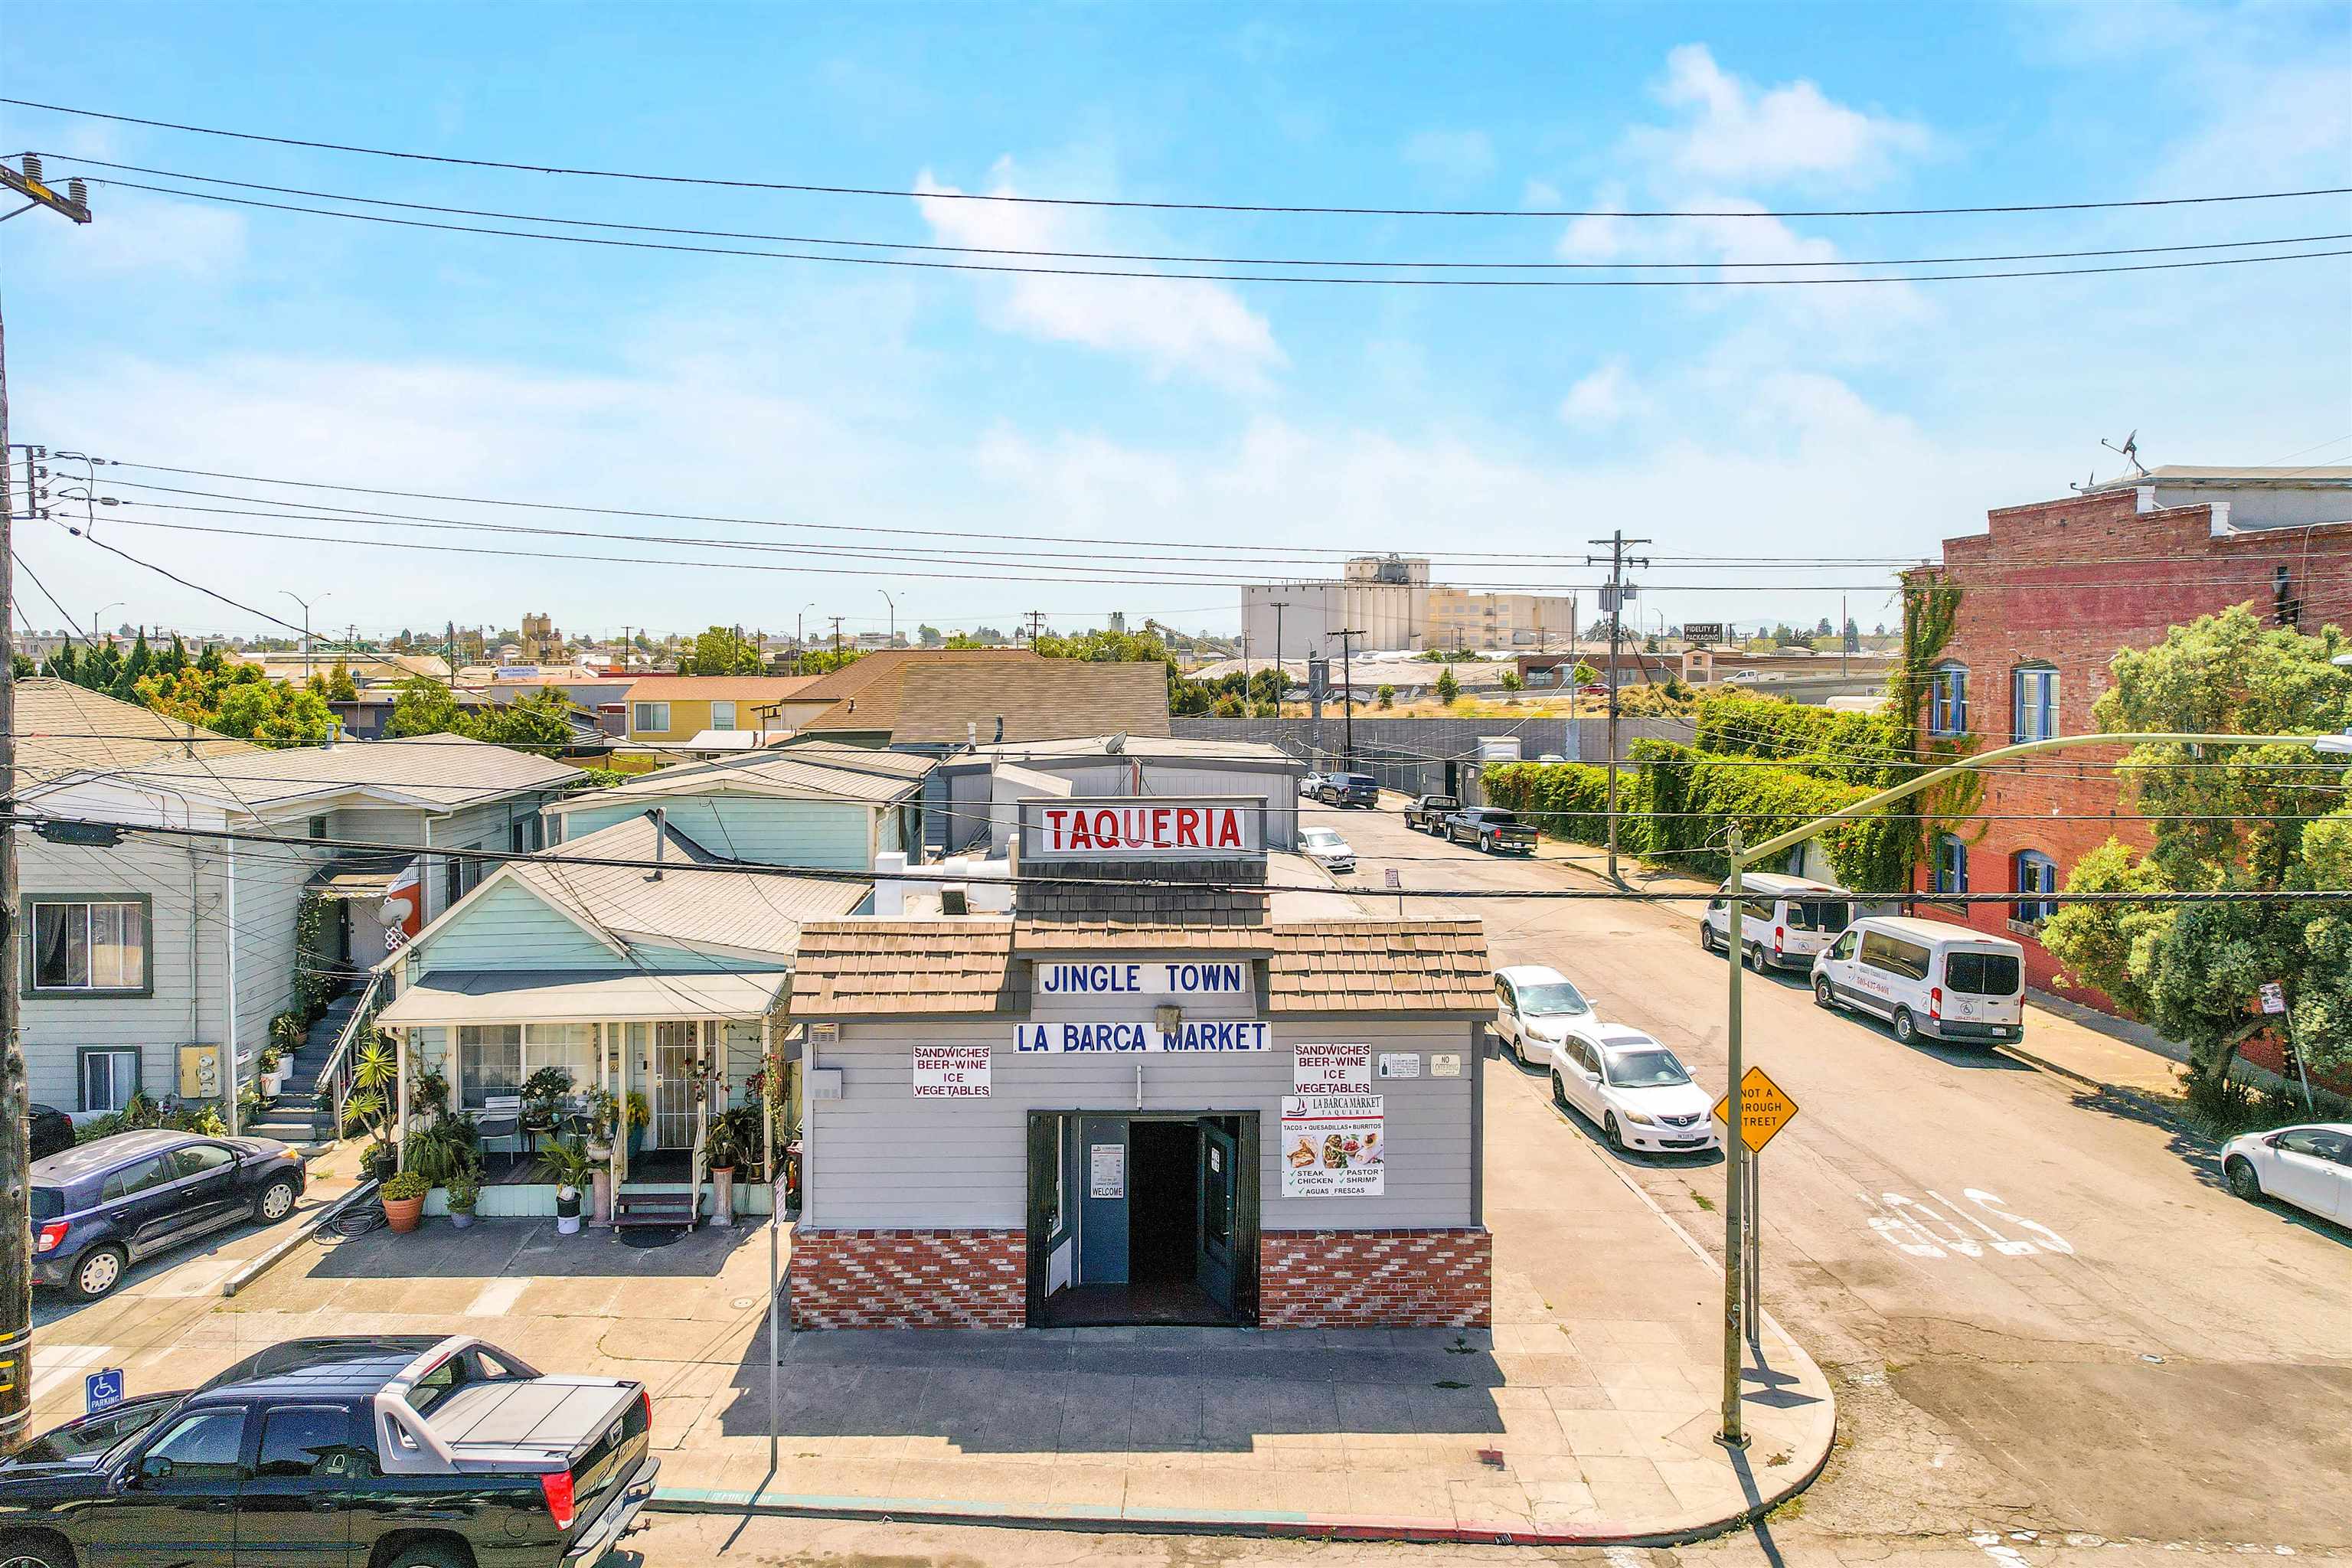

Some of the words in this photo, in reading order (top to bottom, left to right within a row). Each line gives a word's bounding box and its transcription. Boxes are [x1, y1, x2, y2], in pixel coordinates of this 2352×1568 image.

[1046, 808, 1243, 849] TAQUERIA
[1044, 965, 1141, 992] JINGLE
[1165, 964, 1240, 992] TOWN
[1018, 1024, 1049, 1052] LA
[1063, 1024, 1147, 1052] BARCA
[1163, 1023, 1266, 1051] MARKET
[914, 1048, 989, 1058] SANDWICHES
[1295, 1045, 1370, 1055] SANDWICHES
[917, 1060, 987, 1070] BEER-WINE
[1298, 1057, 1367, 1067] BEER-WINE
[943, 1073, 964, 1082] ICE
[1324, 1070, 1345, 1079] ICE
[915, 1086, 989, 1096] VEGETABLES
[1295, 1083, 1370, 1093] VEGETABLES
[1741, 1089, 1760, 1098] NOT
[1766, 1089, 1773, 1097] A
[1313, 1098, 1322, 1109] LA
[1324, 1097, 1349, 1109] BARCA
[1350, 1096, 1380, 1108] MARKET
[1741, 1102, 1782, 1112] ROUGH
[1741, 1117, 1777, 1126] TREET
[1093, 1187, 1122, 1196] WELCOME
[91, 1395, 119, 1409] PARKING
